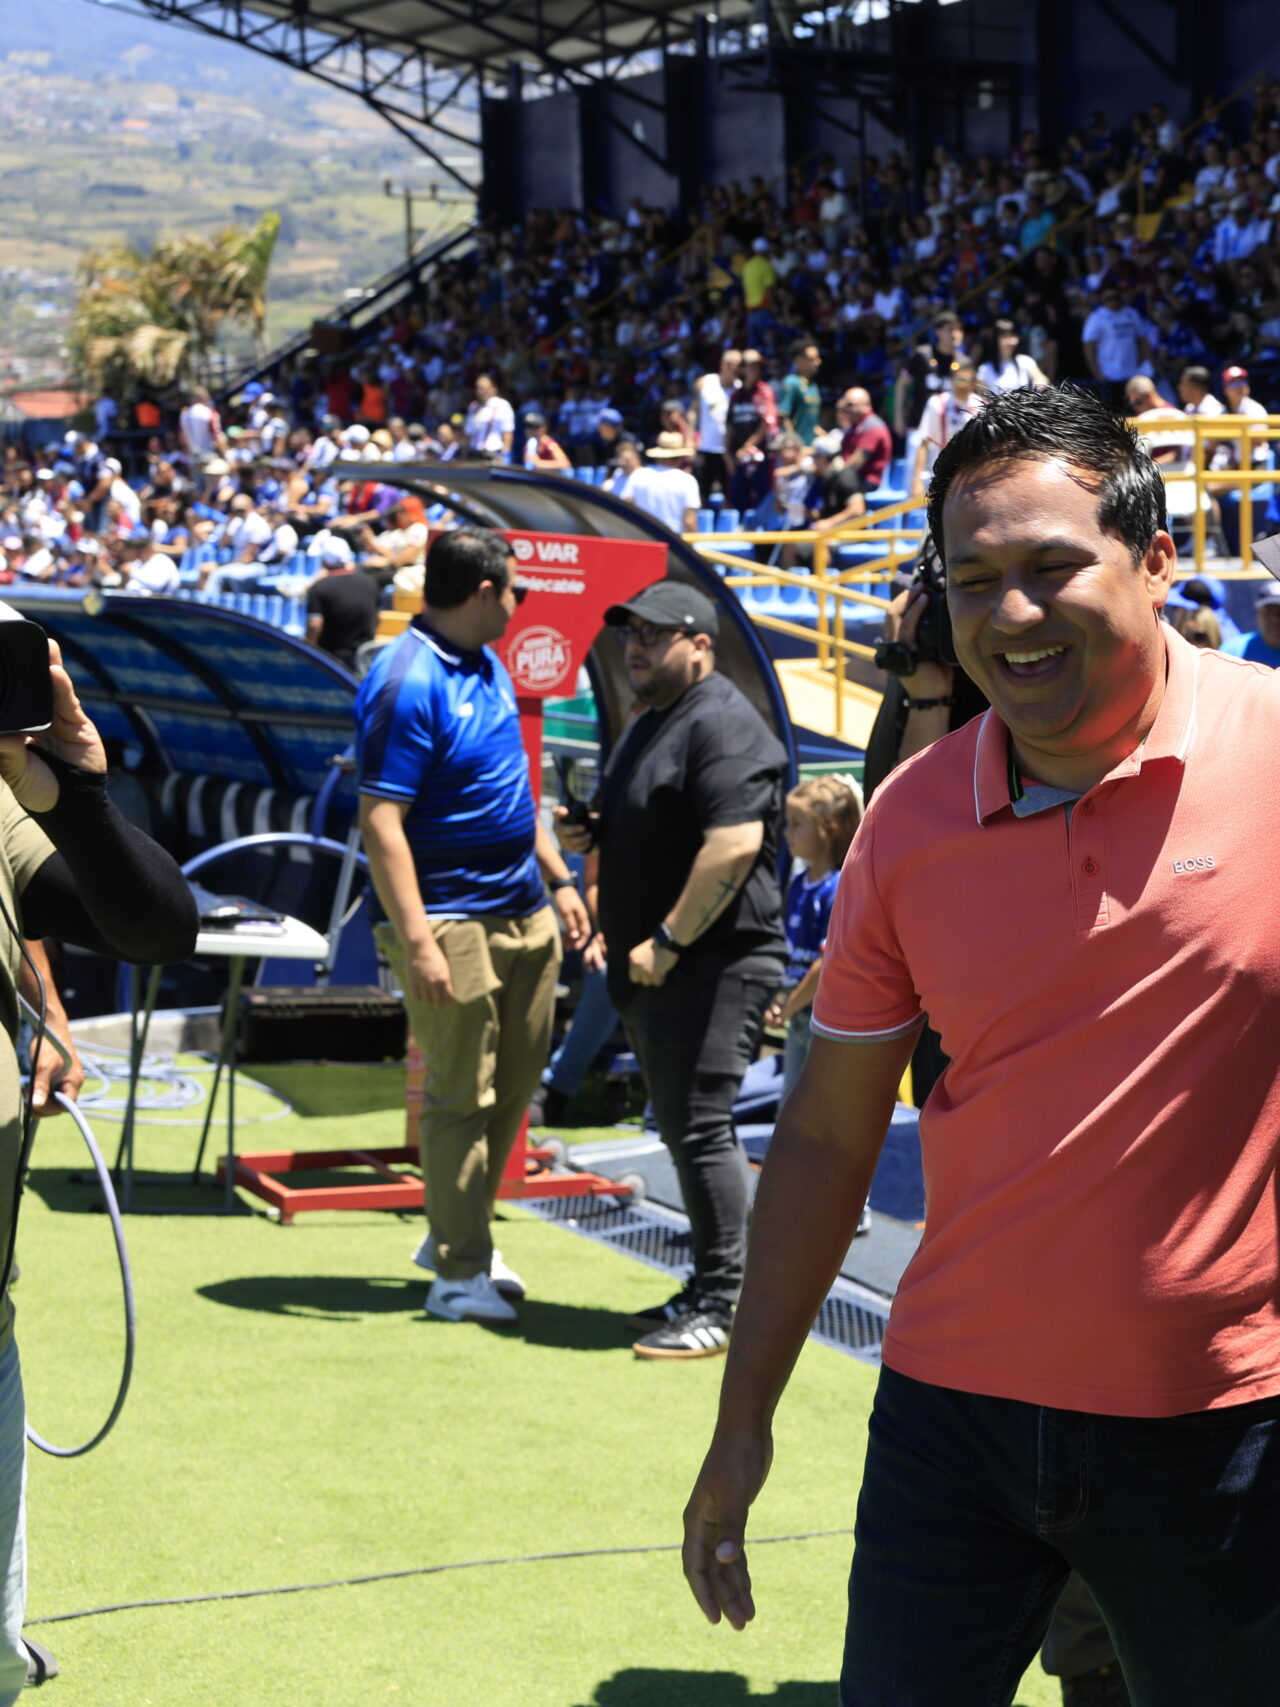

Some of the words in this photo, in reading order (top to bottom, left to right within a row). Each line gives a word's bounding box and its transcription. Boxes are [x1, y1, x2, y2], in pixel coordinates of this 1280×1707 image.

[536, 541, 579, 563] VAR
[516, 645, 565, 672] PURA
[1173, 855, 1217, 874] BOSS
